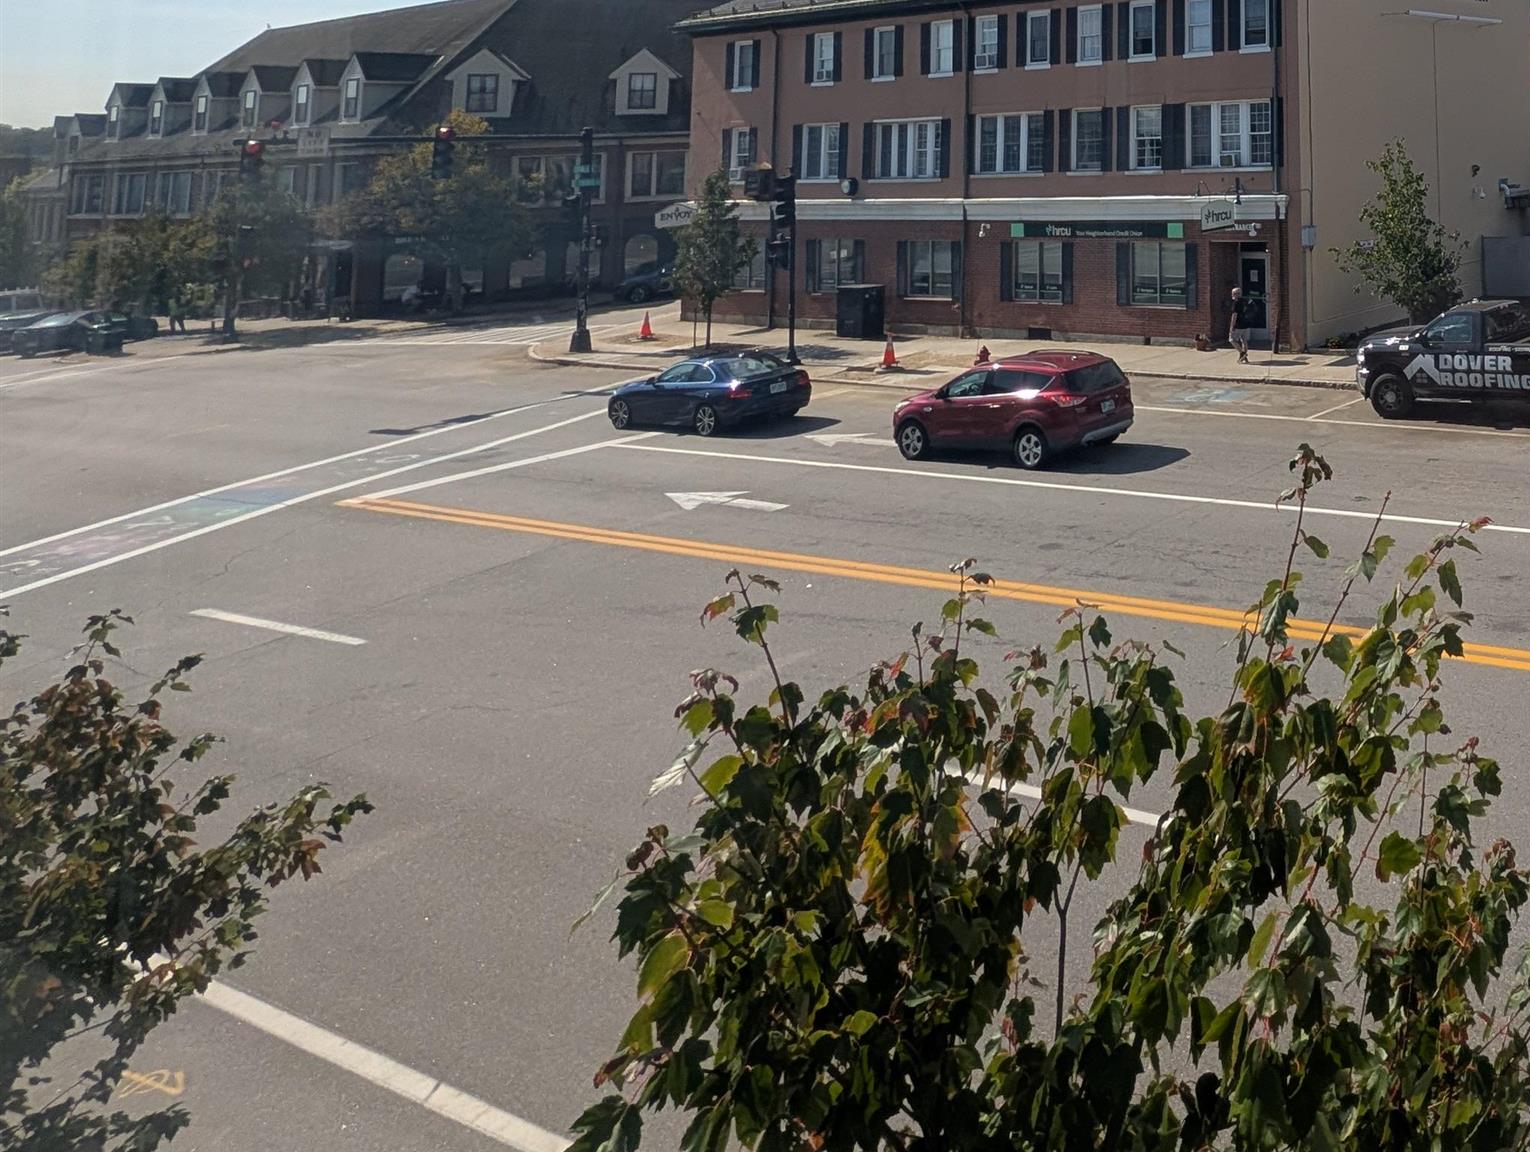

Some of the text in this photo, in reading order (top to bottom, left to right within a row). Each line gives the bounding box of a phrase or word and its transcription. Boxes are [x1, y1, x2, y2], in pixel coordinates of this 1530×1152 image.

[660, 211, 692, 221] ENVOY
[1211, 209, 1232, 223] hrcu
[1052, 225, 1072, 236] hrcu
[1439, 354, 1513, 372] DOVER
